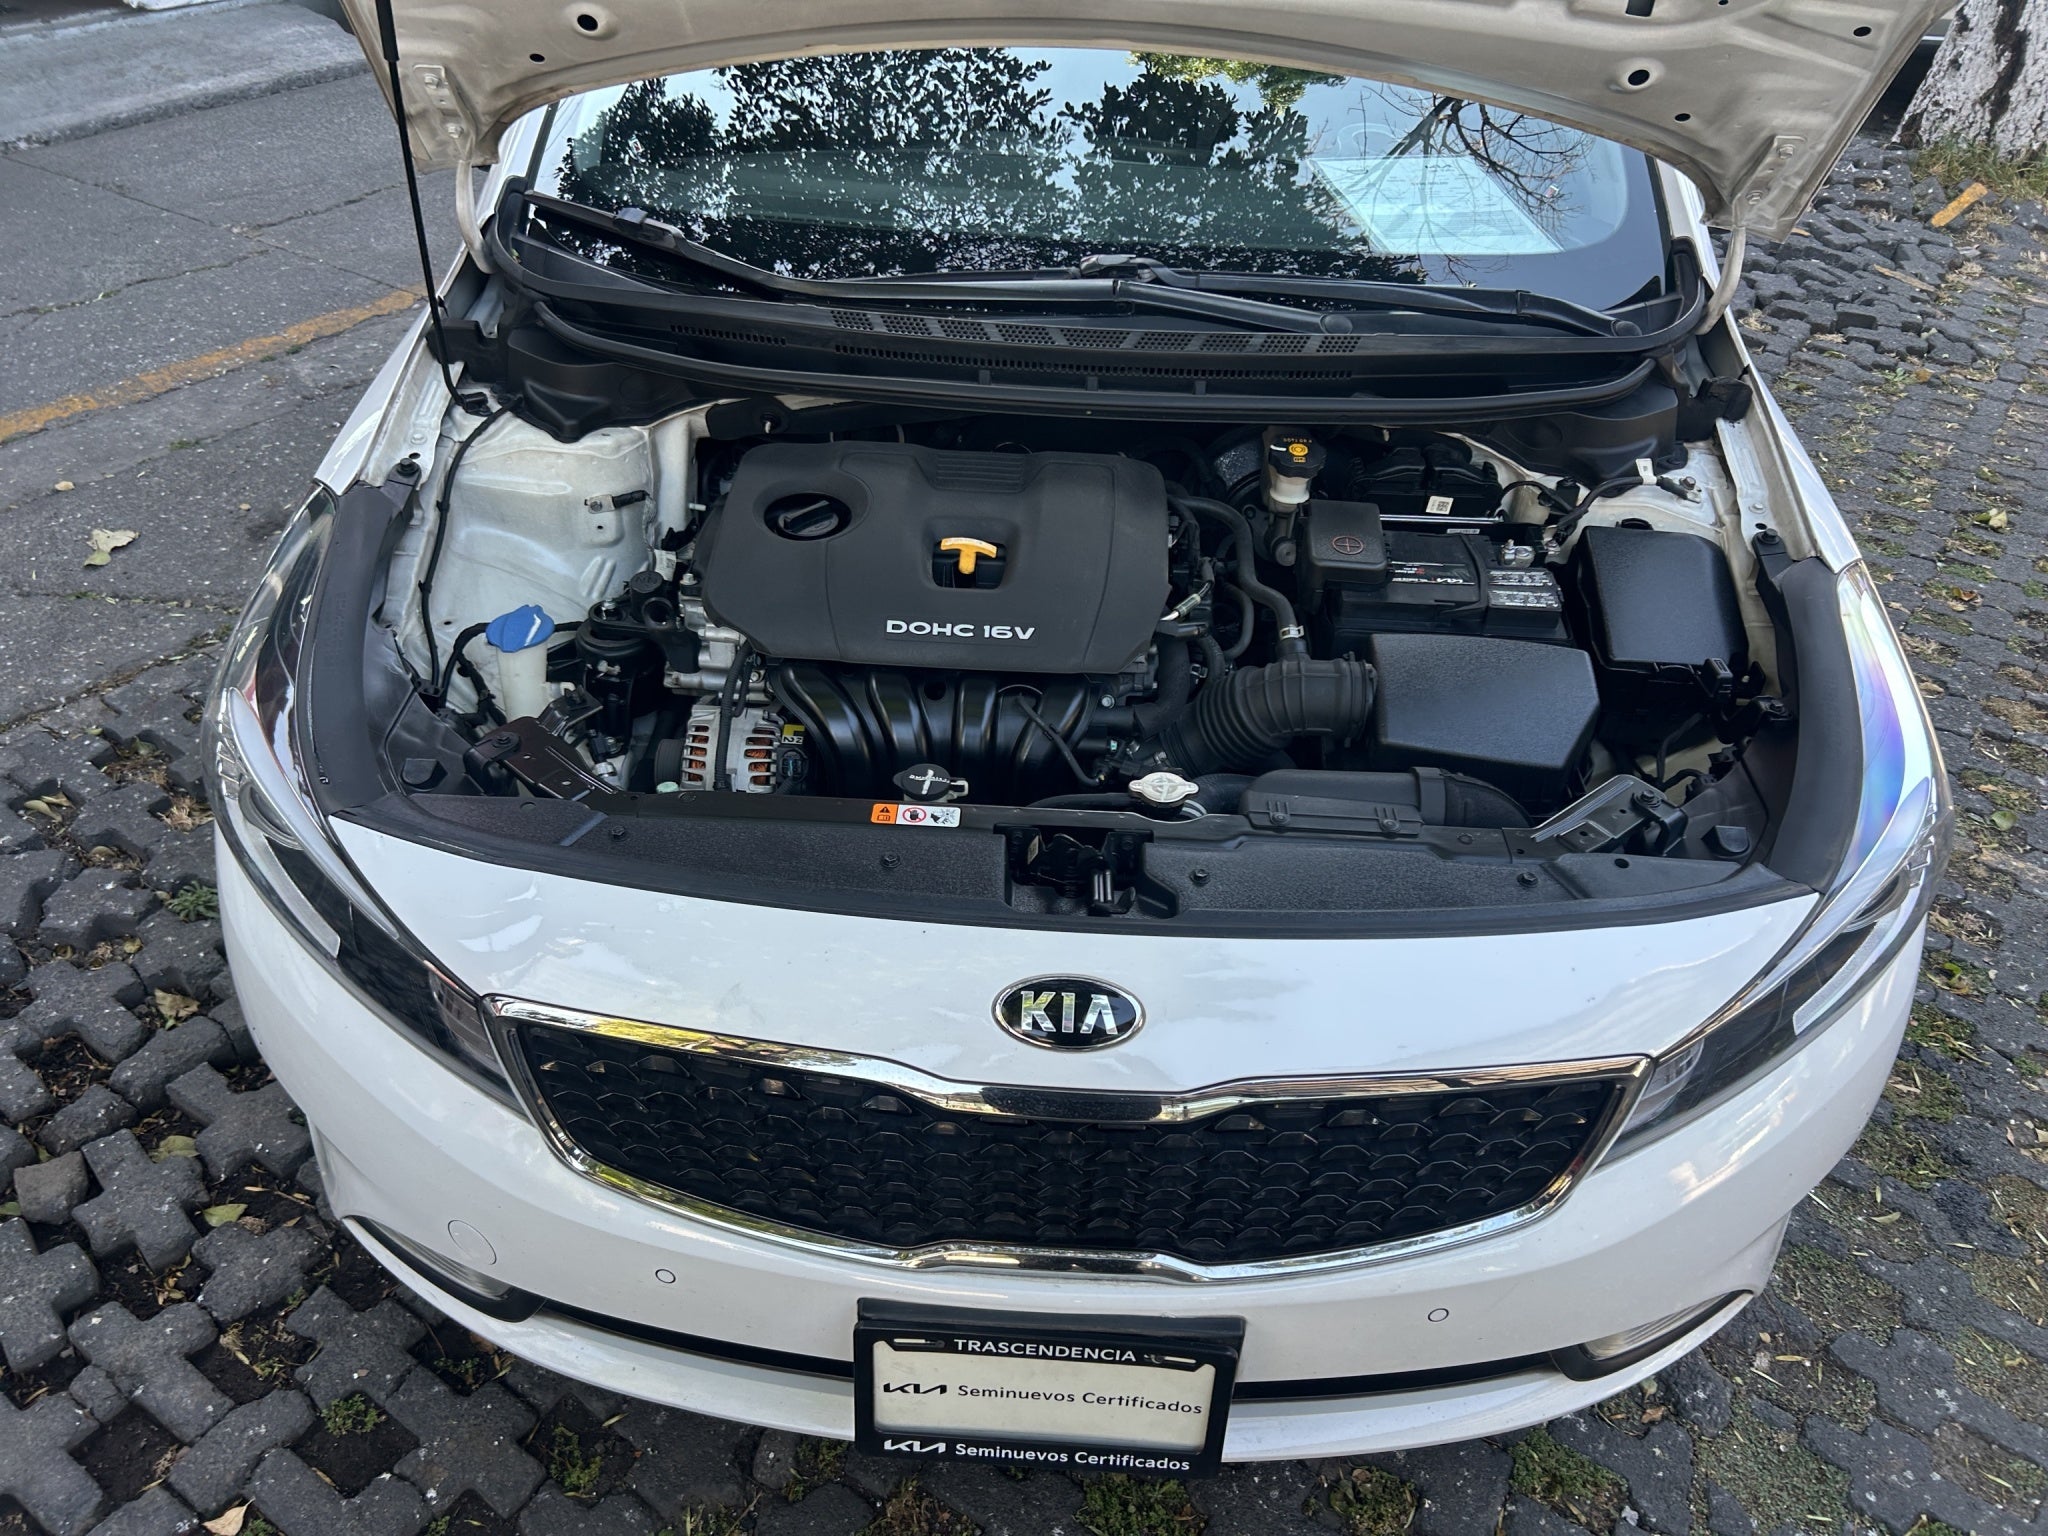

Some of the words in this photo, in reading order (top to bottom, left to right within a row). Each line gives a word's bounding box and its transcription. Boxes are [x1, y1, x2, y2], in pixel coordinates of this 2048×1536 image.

[886, 619, 975, 637] DOHC
[983, 624, 1035, 640] 16V
[1020, 990, 1118, 1035] KIA
[953, 1338, 1136, 1362] TRASCENDENCIA
[883, 1382, 948, 1395] KIA
[958, 1384, 1075, 1403] Seminuevos
[1082, 1392, 1202, 1414] Certificados
[883, 1438, 947, 1454] KIA
[955, 1443, 1069, 1462] Seminuevos
[1075, 1451, 1190, 1471] Certificados
